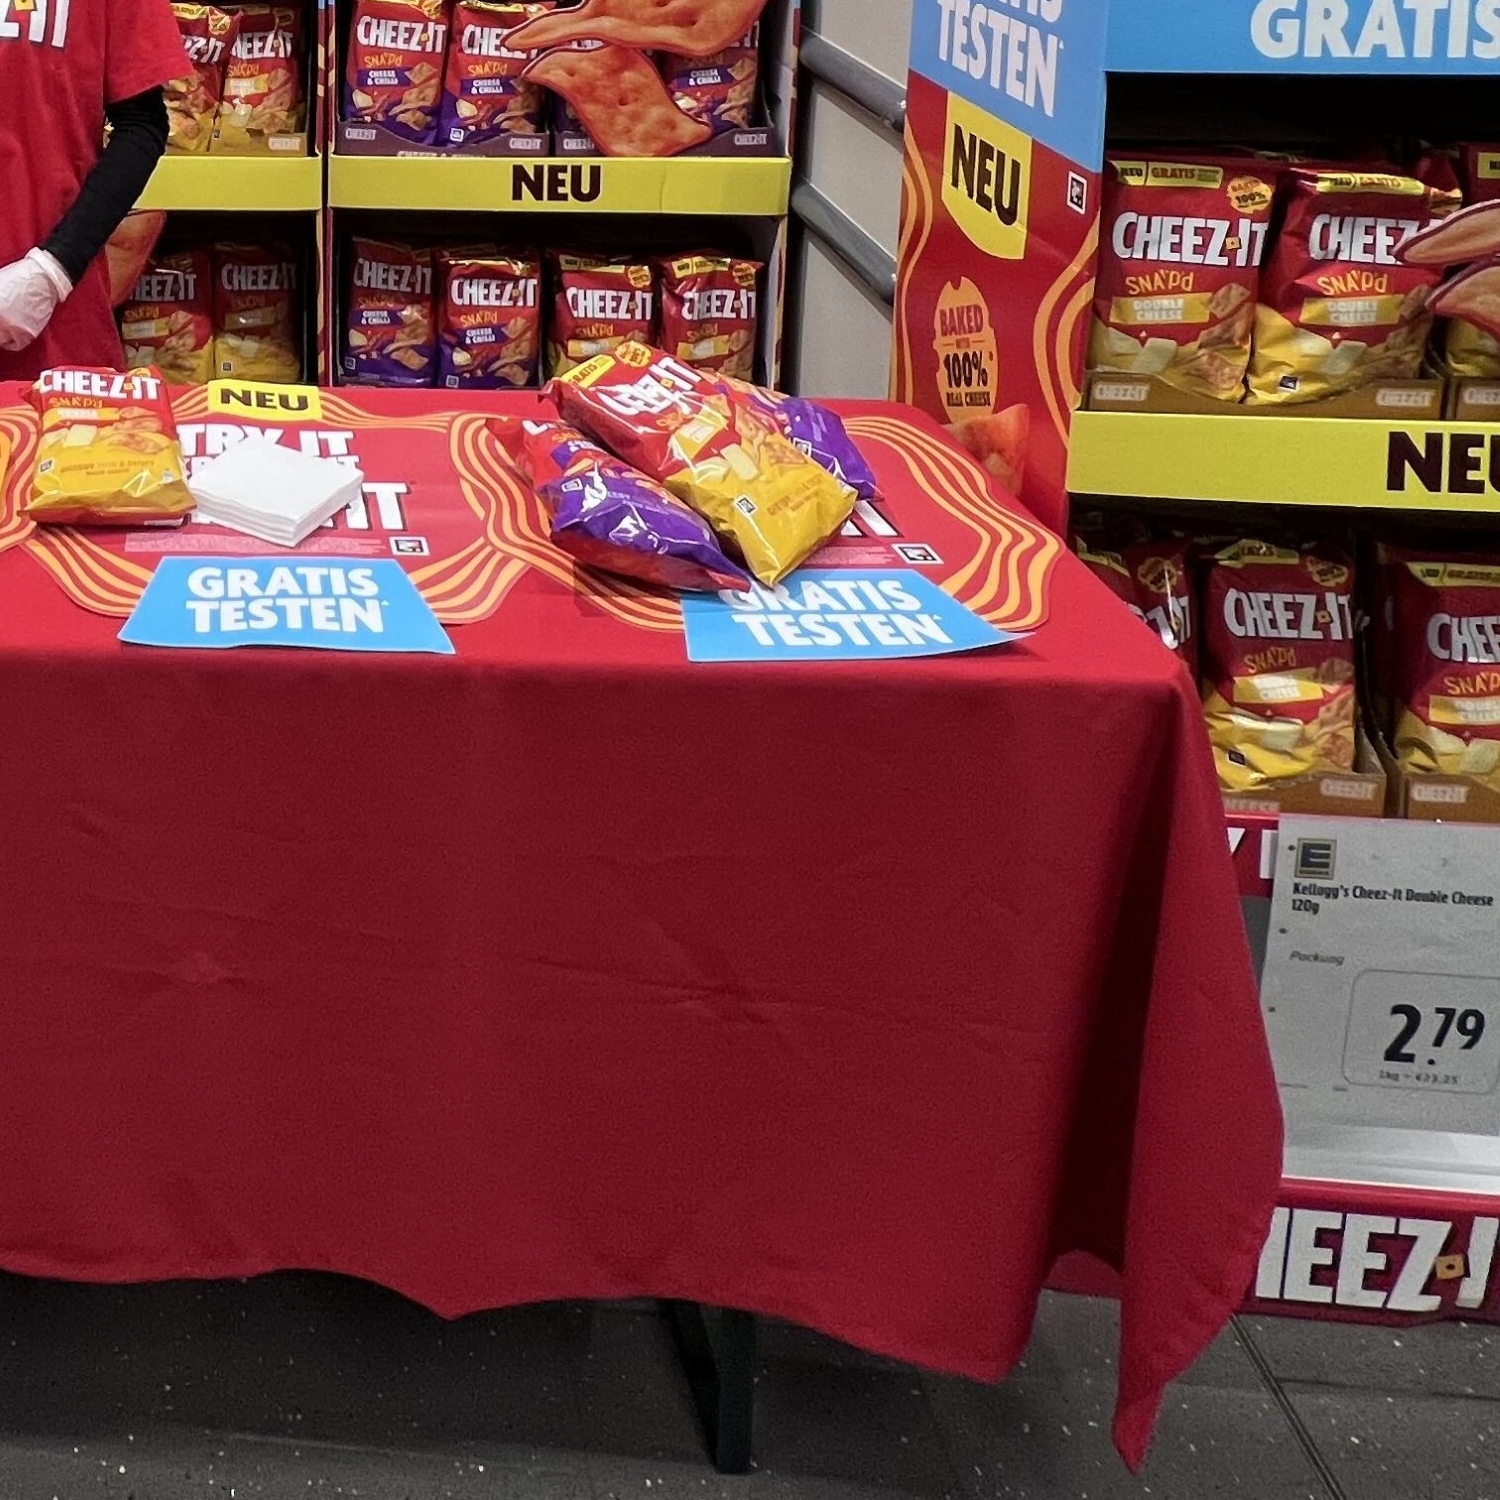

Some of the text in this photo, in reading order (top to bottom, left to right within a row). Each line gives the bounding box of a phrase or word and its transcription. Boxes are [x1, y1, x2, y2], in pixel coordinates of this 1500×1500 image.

[368, 70, 397, 78] CHEESE
[472, 79, 501, 87] CHEESE
[512, 164, 601, 202] NEU
[951, 122, 1021, 225] NEU
[1151, 168, 1196, 179] GRATIS
[1132, 299, 1184, 311] DOUBLE
[1135, 309, 1183, 321] CHEESE
[1327, 301, 1379, 313] DOUBLE
[940, 304, 984, 337] BAKED
[1329, 311, 1377, 323] CHEESE
[943, 350, 989, 389] 100%
[220, 387, 309, 412] NEU
[964, 391, 991, 407] CHEESE
[299, 430, 354, 456] IT
[186, 567, 379, 598] GRATIS
[717, 580, 923, 612] GRATIS
[185, 600, 385, 633] TESTEN
[731, 613, 954, 646] TESTEN
[1291, 899, 1320, 915] 120g
[1293, 884, 1349, 899] Kellogg's
[1406, 888, 1449, 904] Double
[1452, 891, 1494, 907] Cheese
[1289, 950, 1345, 967] Packung
